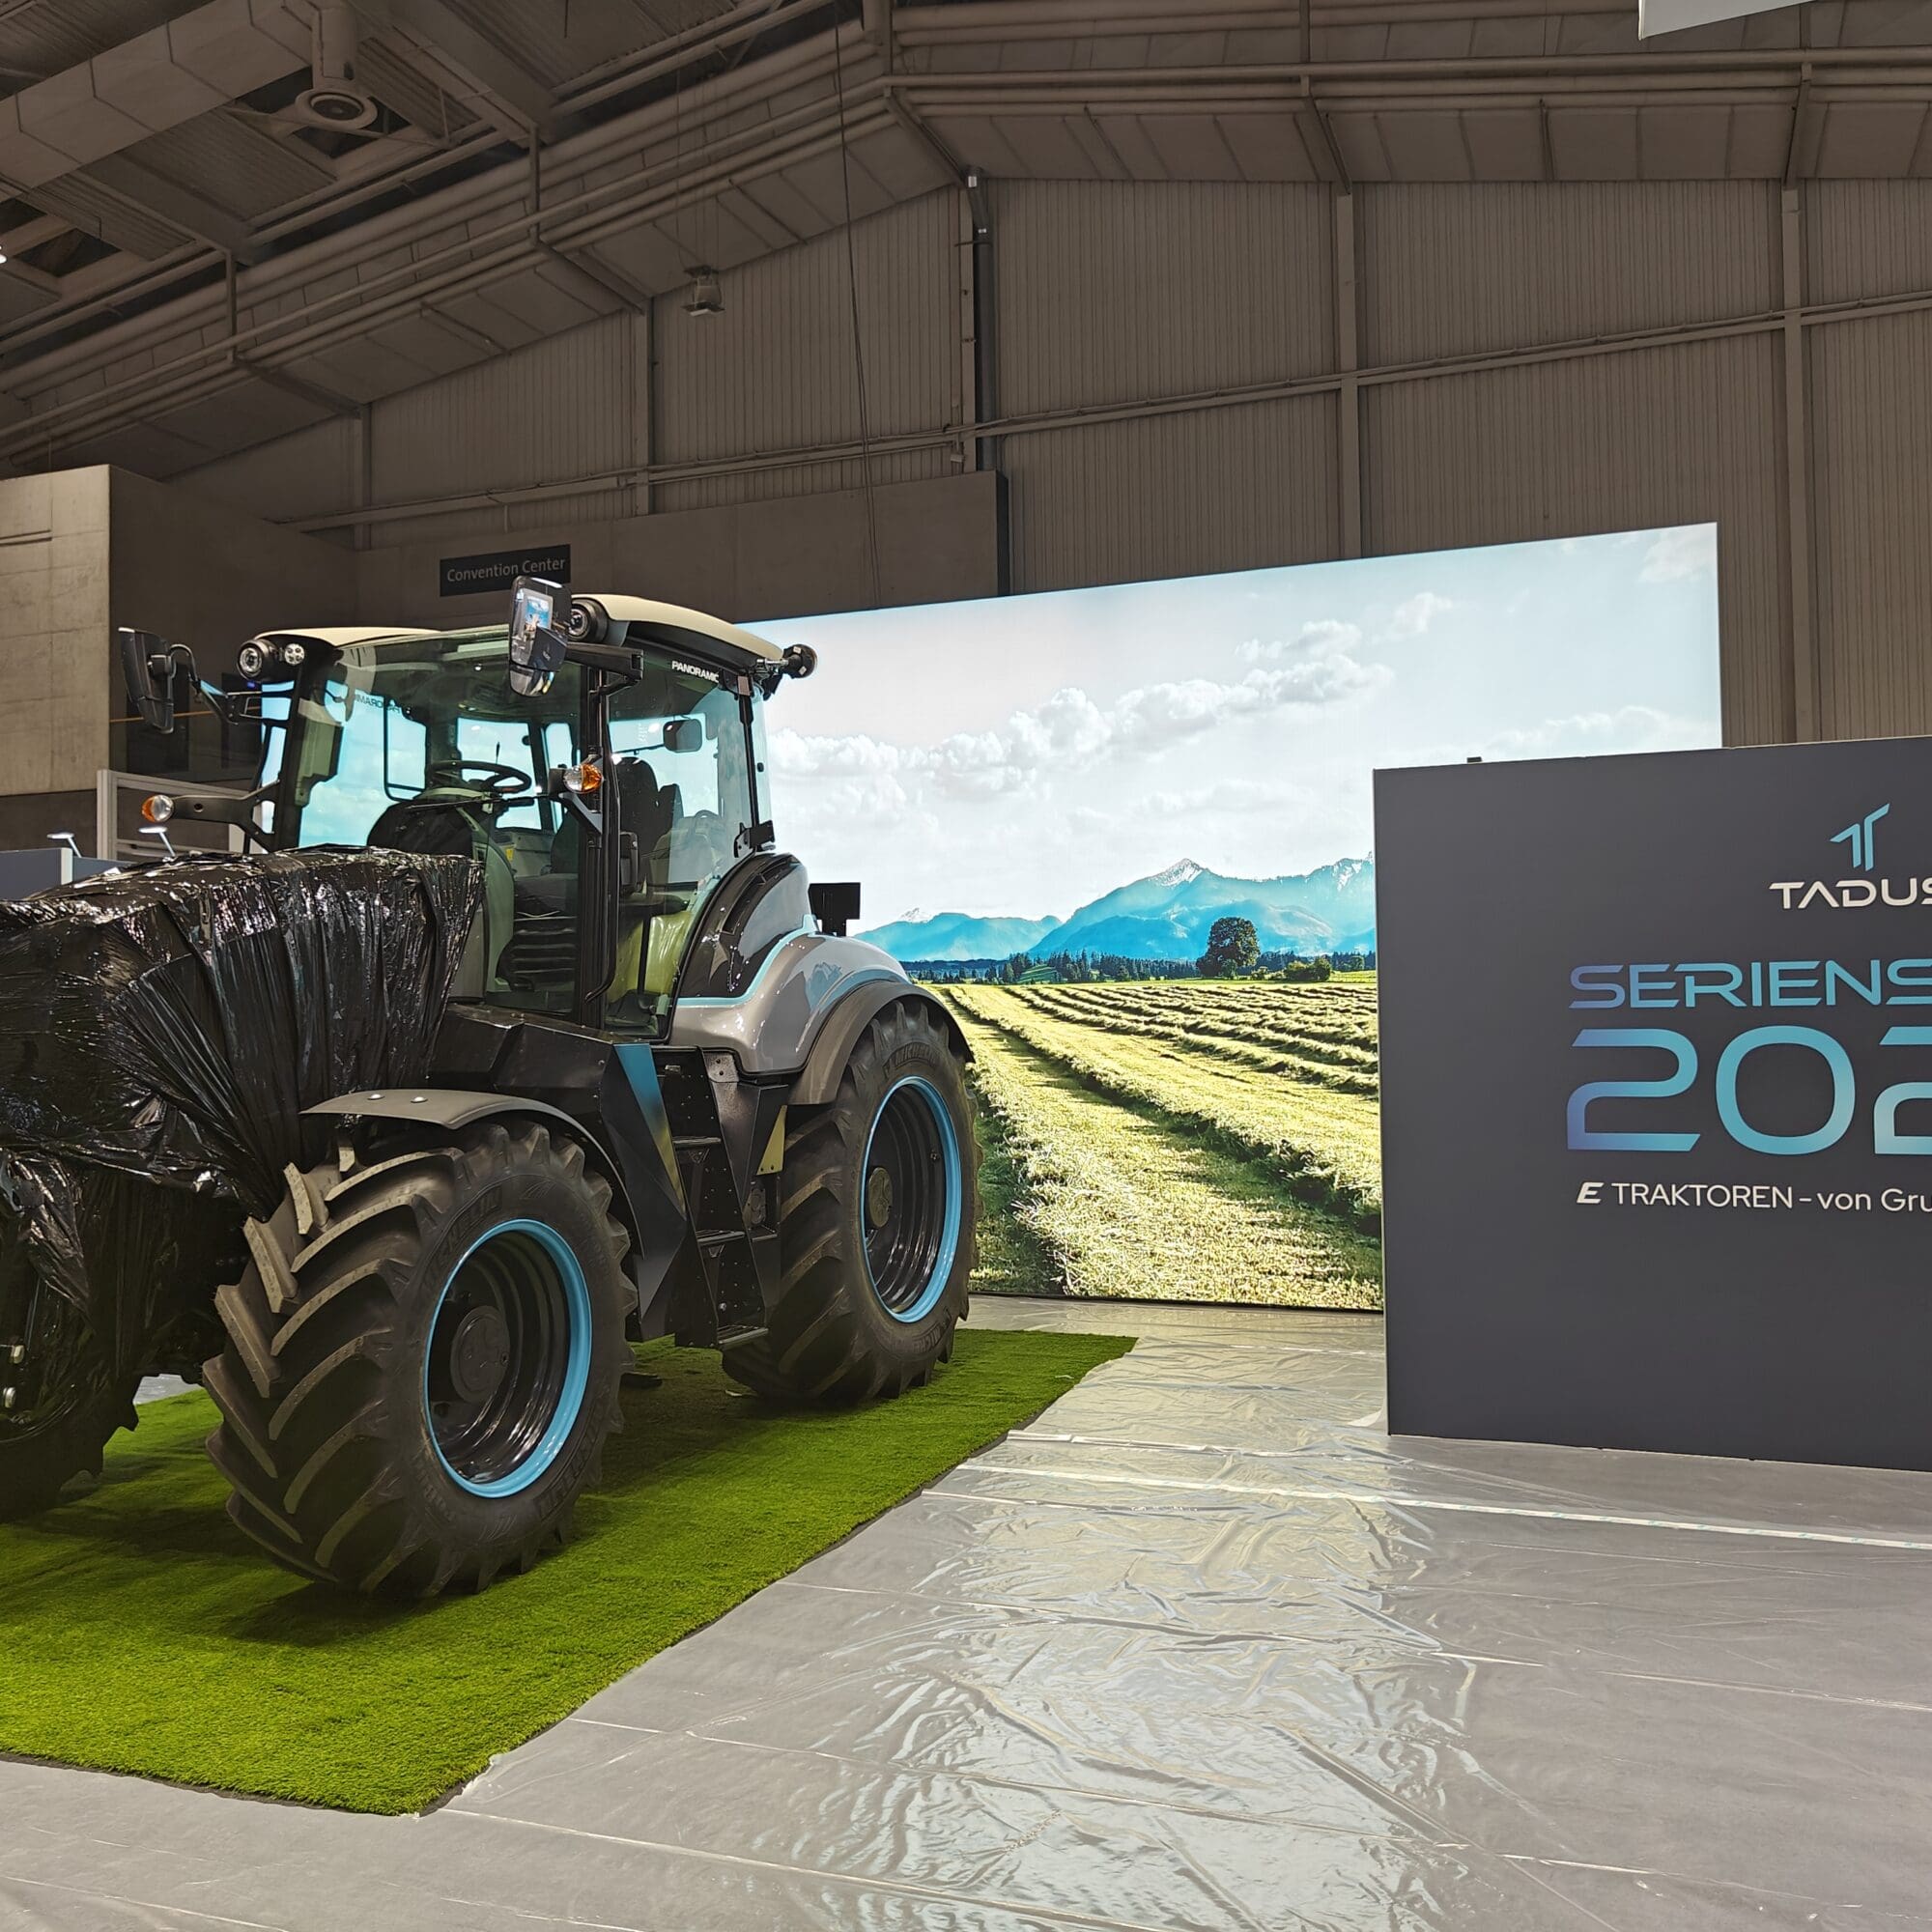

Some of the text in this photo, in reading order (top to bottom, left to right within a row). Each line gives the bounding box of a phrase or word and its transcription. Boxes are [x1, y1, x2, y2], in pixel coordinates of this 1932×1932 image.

[447, 558, 565, 582] Convention Center
[1569, 958, 1932, 1009] SERIENS
[1576, 1181, 1605, 1205] E
[1611, 1181, 1793, 1209] TRAKTOREN
[1816, 1192, 1871, 1210] von
[1881, 1187, 1932, 1212] Gru
